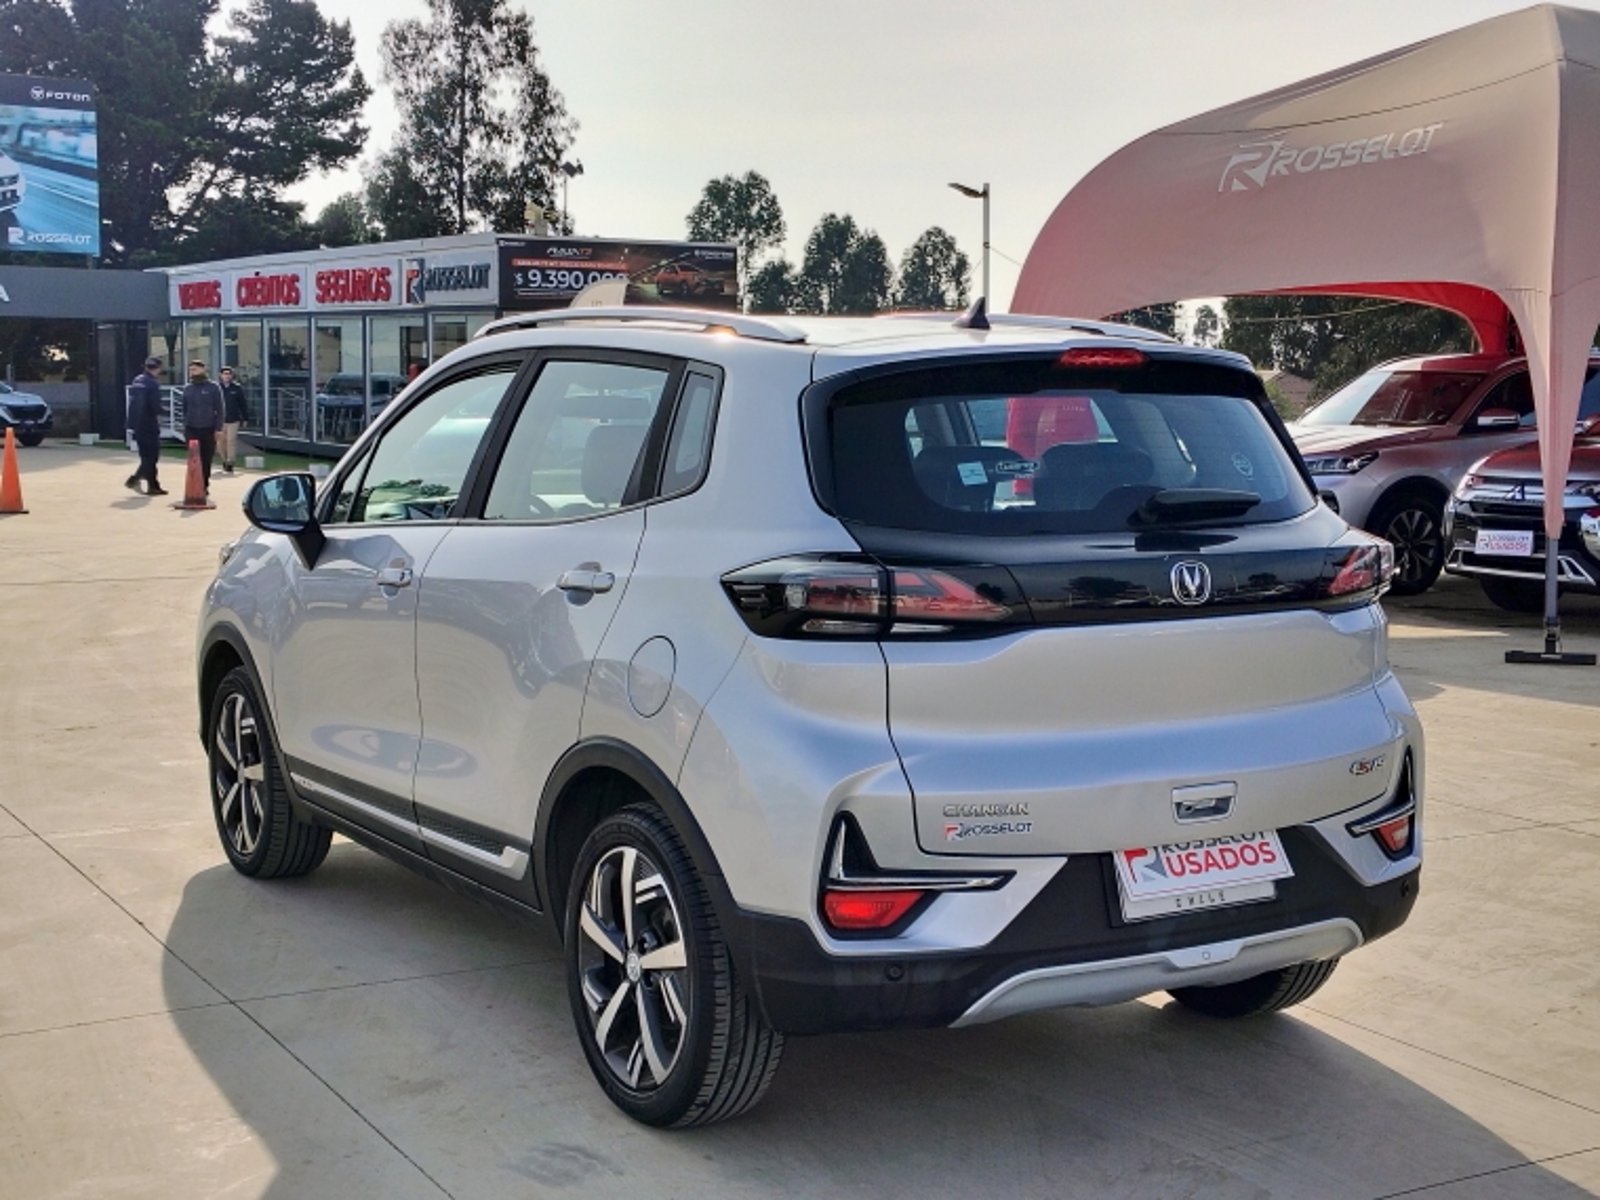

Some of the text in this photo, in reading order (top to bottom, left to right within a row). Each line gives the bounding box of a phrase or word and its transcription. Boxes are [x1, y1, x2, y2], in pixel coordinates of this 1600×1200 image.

[1271, 123, 1443, 176] ROSSELOT
[27, 232, 92, 245] ROSSELOT
[316, 266, 392, 304] SEGUROS
[528, 269, 629, 289] 9.3900
[963, 822, 1033, 838] ROSSELOT
[1165, 841, 1278, 878] USADOS
